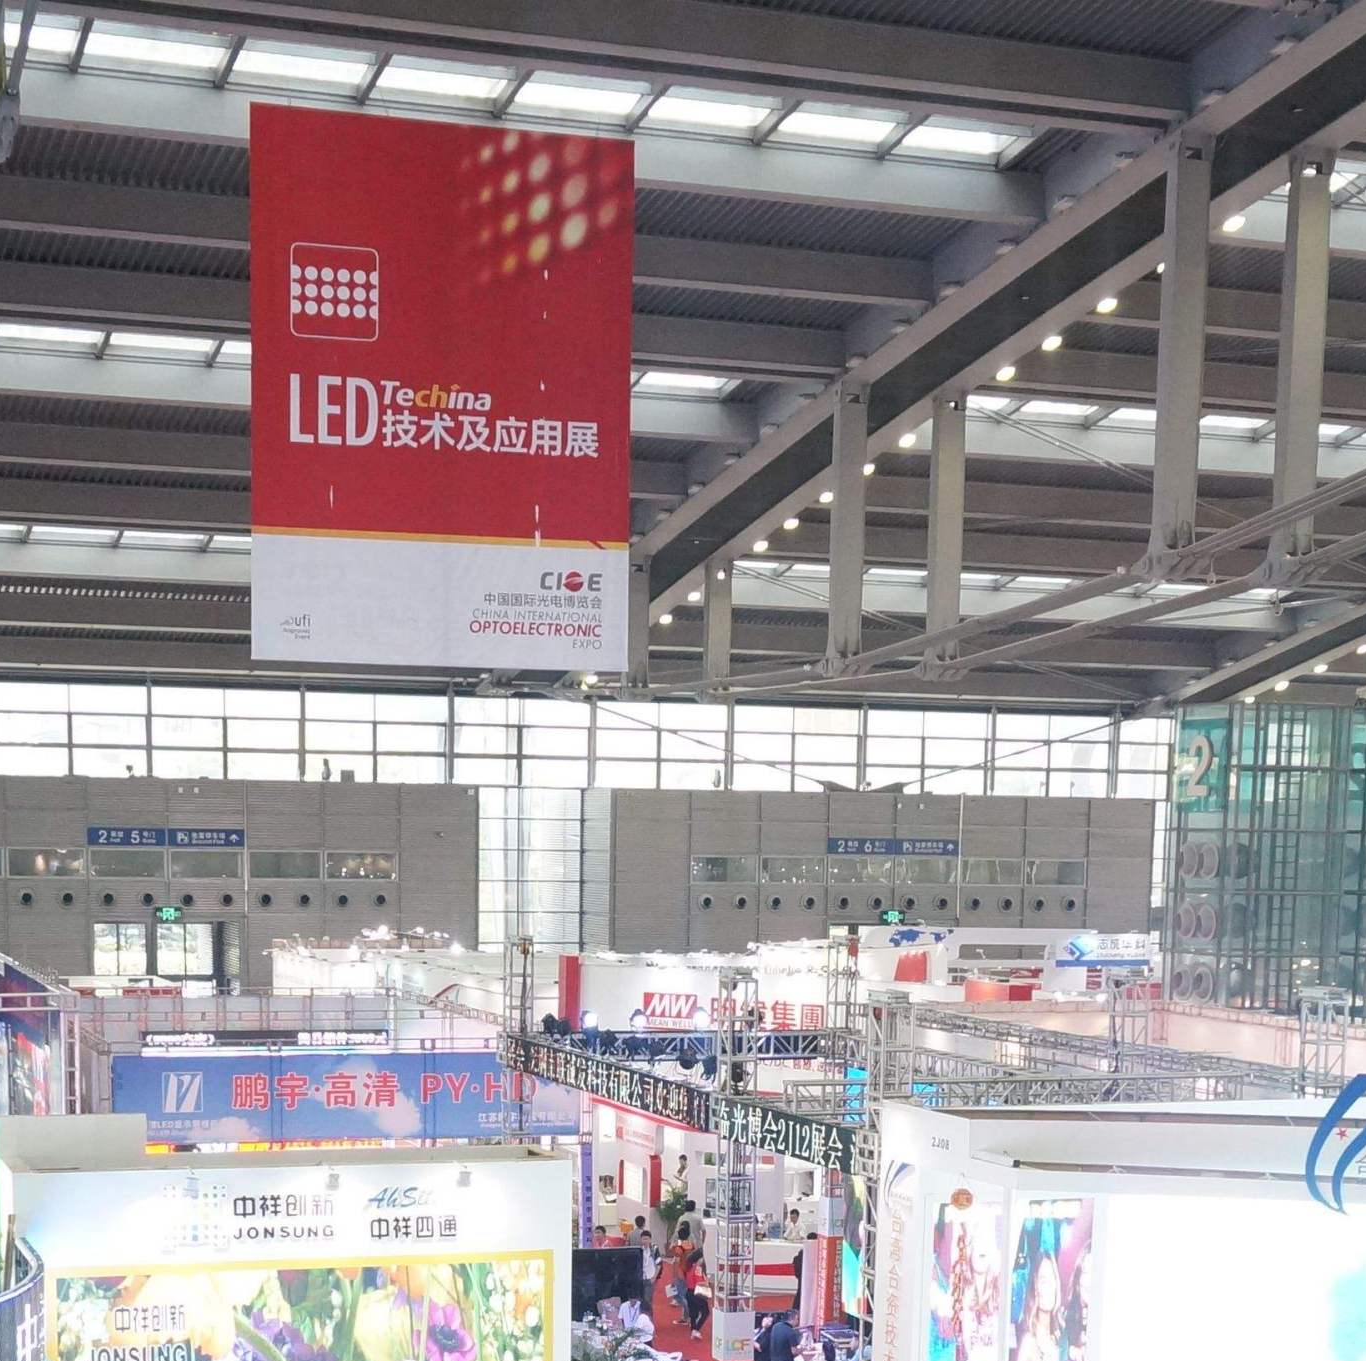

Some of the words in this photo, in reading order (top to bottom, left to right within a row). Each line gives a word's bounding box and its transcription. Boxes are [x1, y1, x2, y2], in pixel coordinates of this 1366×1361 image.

[380, 380, 492, 412] Techina
[289, 372, 377, 446] LED
[381, 410, 600, 458] 技术及应用展
[483, 591, 603, 609] 中国国际光电博览会
[471, 608, 511, 620] CHINA
[513, 609, 603, 623] INTERNATIONAL
[469, 620, 602, 638] OPTOELECTRONIC
[572, 638, 603, 650] EXPO
[1186, 735, 1213, 797] 2
[97, 830, 108, 844] 2
[130, 830, 141, 844] 5
[645, 993, 696, 1018] MW
[233, 1194, 335, 1218] 中祥创新
[233, 1224, 335, 1240] JONSUNG
[370, 1214, 458, 1240] 中祥四通
[114, 1304, 186, 1332] 中祥创新
